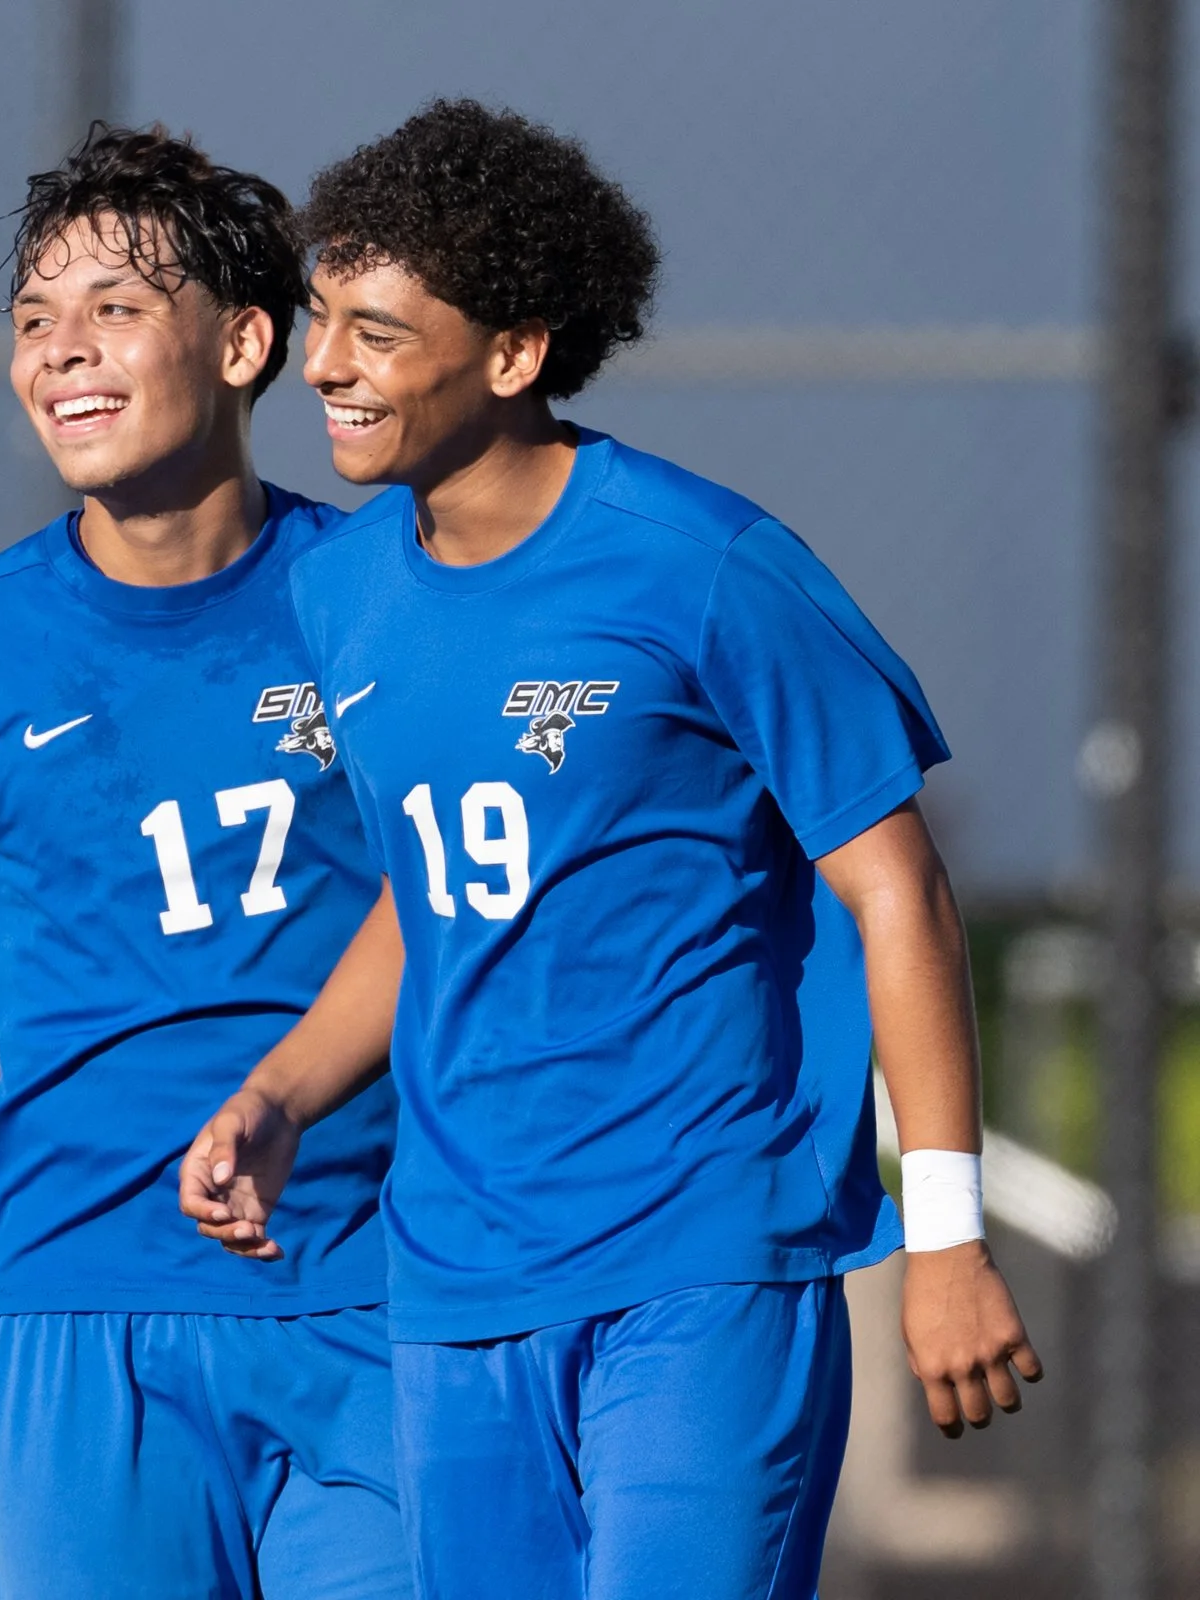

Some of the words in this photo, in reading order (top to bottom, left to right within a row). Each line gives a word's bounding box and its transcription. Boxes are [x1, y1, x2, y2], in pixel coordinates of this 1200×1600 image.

[502, 681, 620, 716] SMC
[140, 778, 296, 936] 17
[402, 781, 531, 920] 19
